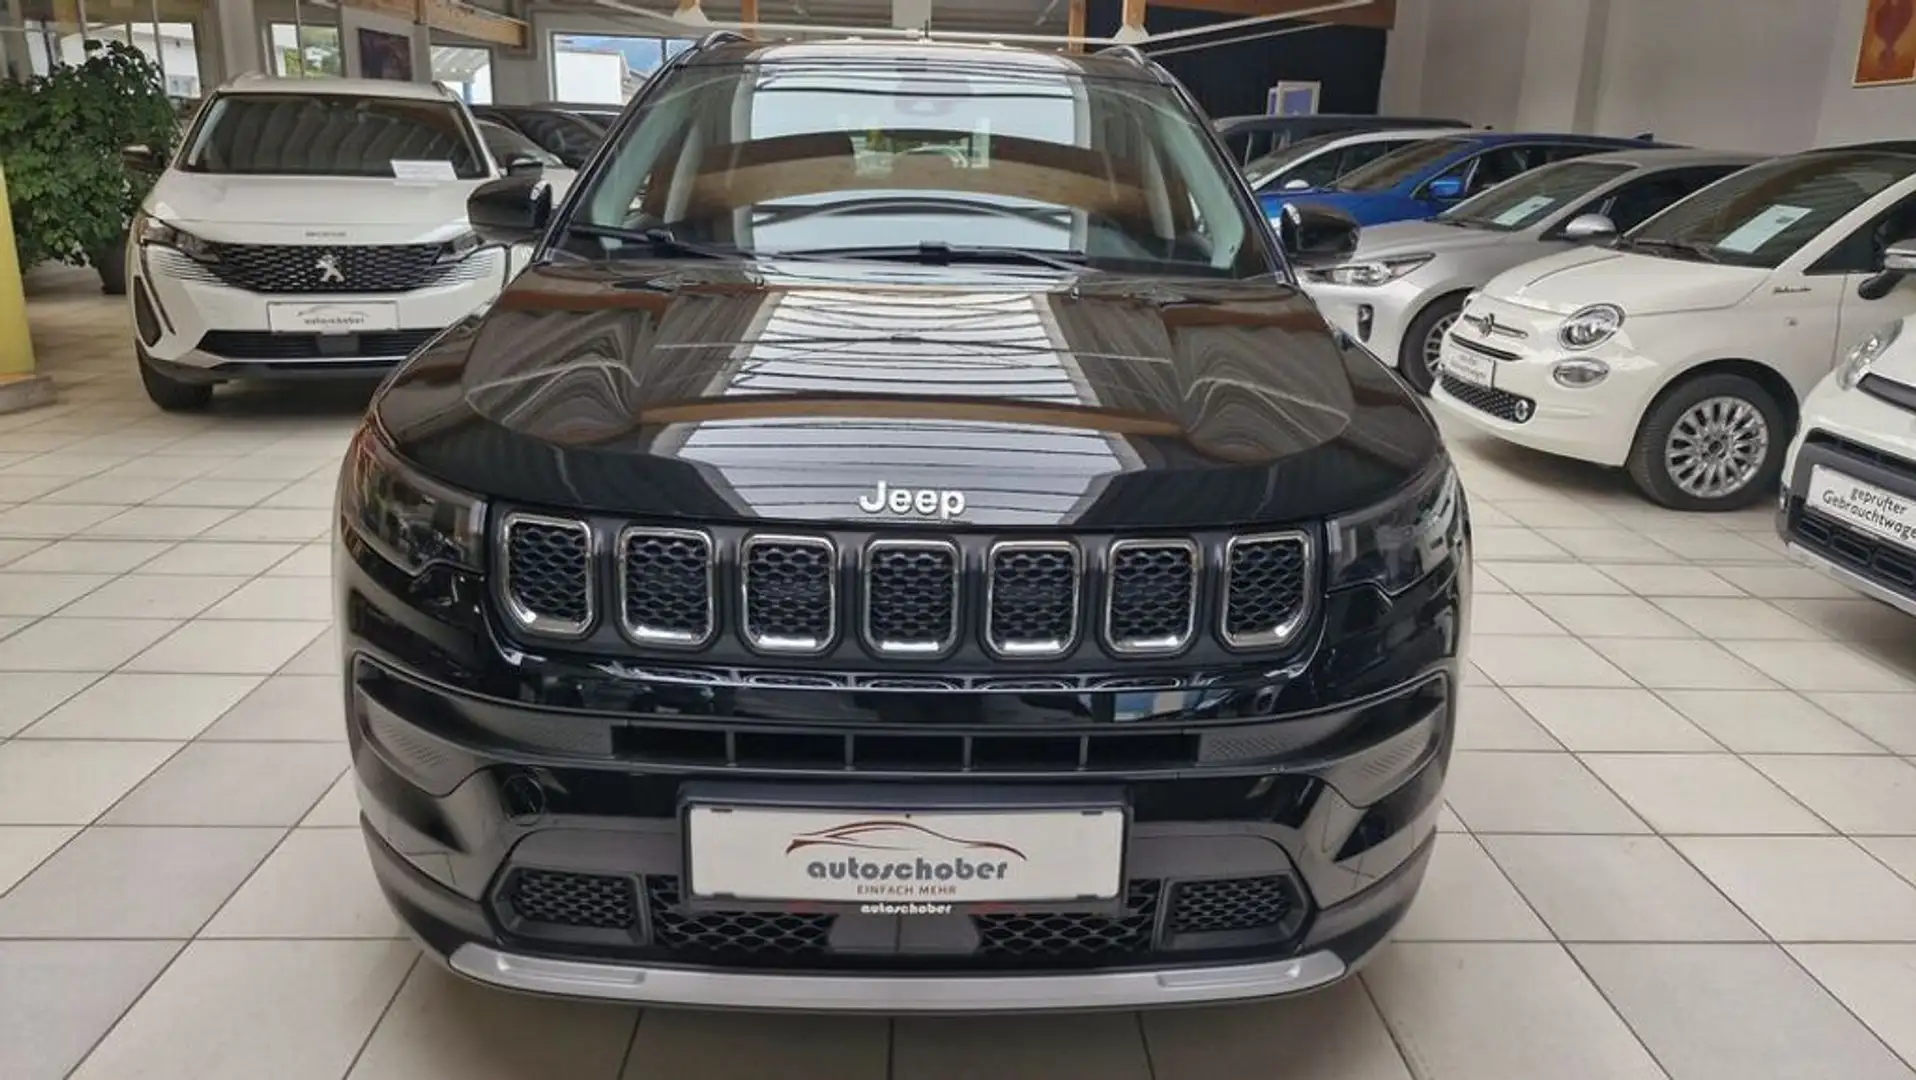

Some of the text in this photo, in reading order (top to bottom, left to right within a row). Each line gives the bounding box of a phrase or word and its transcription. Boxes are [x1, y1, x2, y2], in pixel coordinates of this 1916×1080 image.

[859, 480, 966, 520] Jeep
[807, 857, 1008, 881] autoschober
[857, 884, 957, 896] EINFACH MEHR
[860, 903, 952, 915] autoschober
